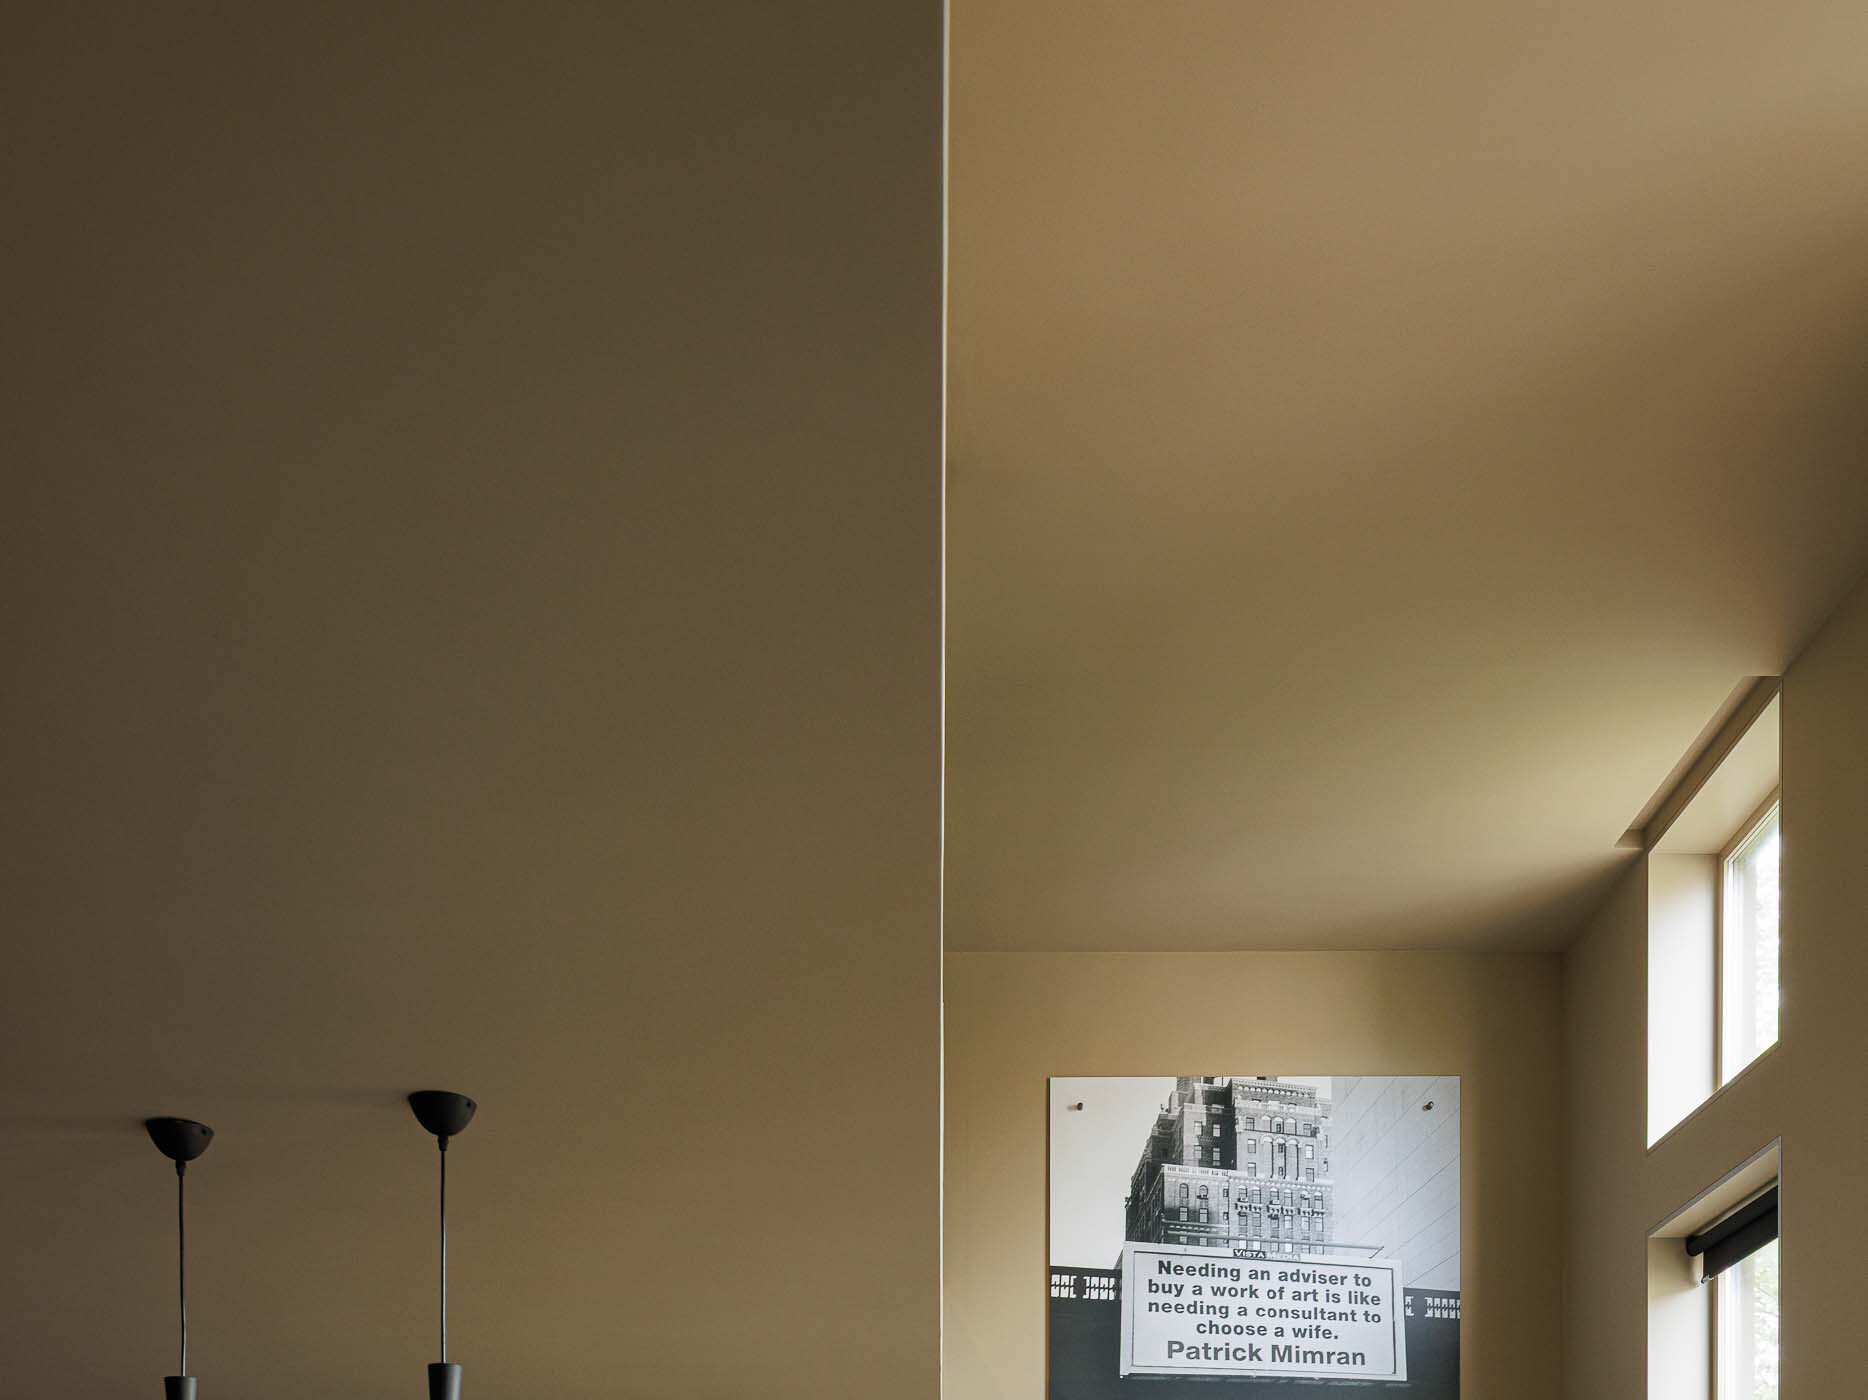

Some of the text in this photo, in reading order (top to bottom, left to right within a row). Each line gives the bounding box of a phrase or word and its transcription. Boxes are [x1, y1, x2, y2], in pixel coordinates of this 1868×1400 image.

[1234, 1249, 1265, 1258] VISTA
[1158, 1260, 1372, 1287] Needing an adviser to
[1148, 1279, 1381, 1305] buy a work of art is like
[1148, 1300, 1382, 1323] needing a consultant to
[1196, 1320, 1339, 1340] choose a wife.
[1167, 1340, 1366, 1366] Patrick Mimran
